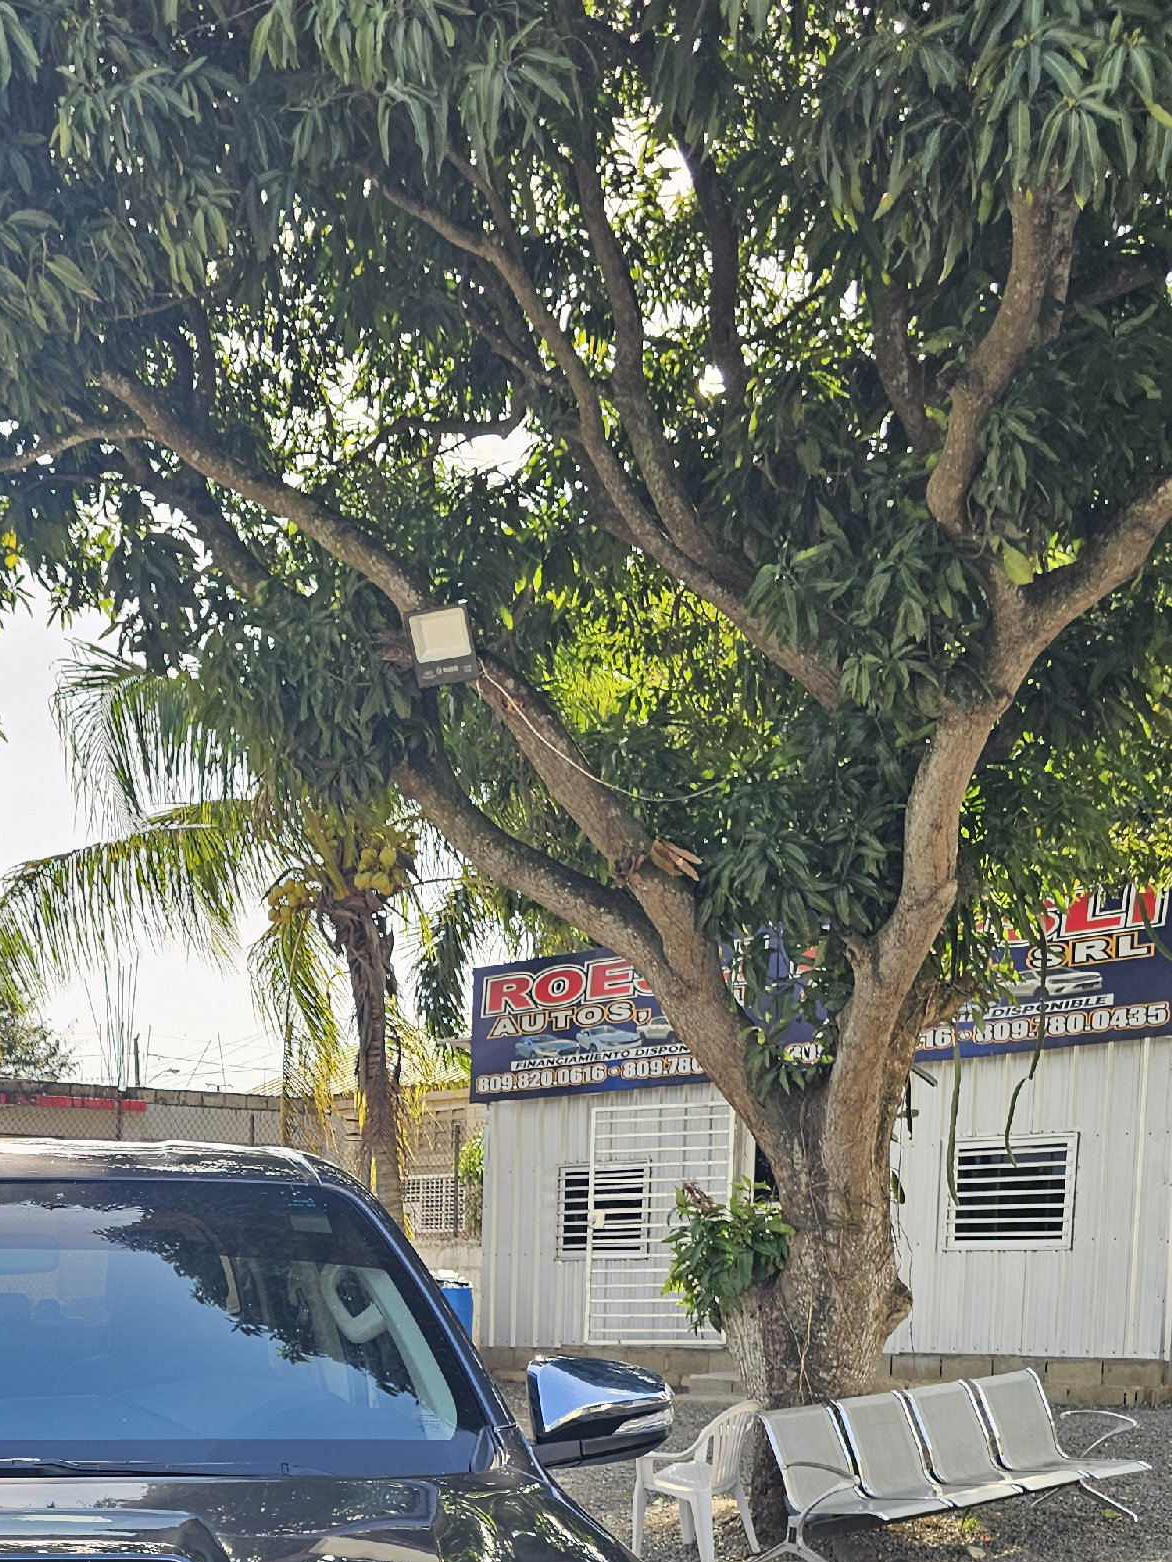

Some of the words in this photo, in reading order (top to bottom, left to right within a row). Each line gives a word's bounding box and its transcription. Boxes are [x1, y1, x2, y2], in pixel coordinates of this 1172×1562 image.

[1026, 931, 1154, 970] SRL
[487, 1000, 651, 1040] AUTOS,
[991, 996, 1107, 1018] DISPONIBLE
[476, 1065, 607, 1094] 809.820.0616
[621, 1055, 706, 1080] 809.780
[515, 1049, 630, 1070] FINANCIAMIENTO
[635, 1044, 691, 1057] DISPON
